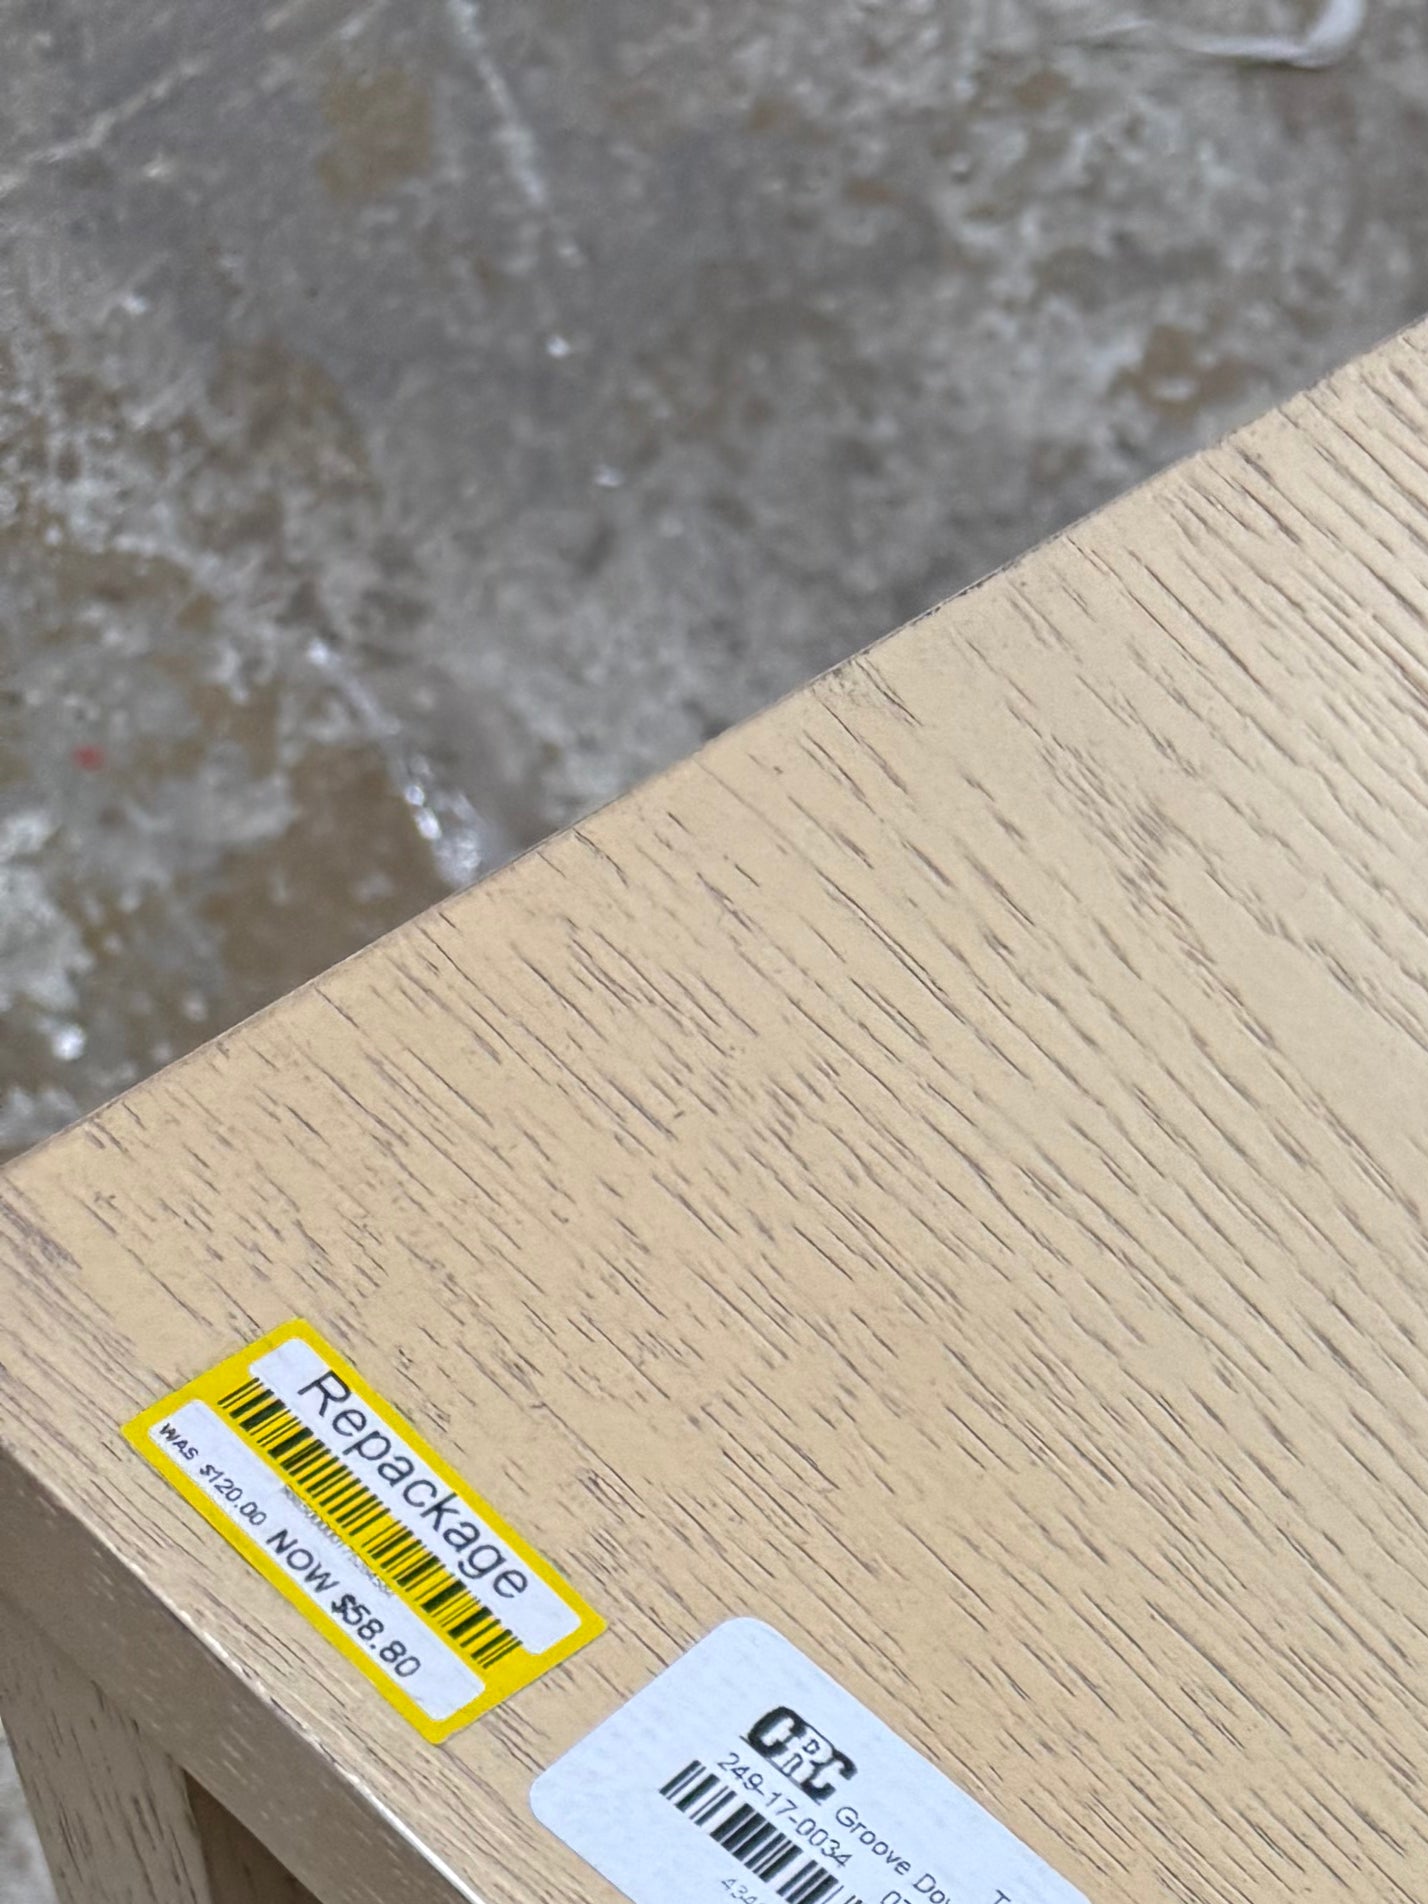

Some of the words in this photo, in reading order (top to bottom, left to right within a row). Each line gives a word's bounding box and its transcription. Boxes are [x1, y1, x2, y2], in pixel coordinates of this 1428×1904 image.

[159, 1423, 199, 1461] WAS
[200, 1463, 267, 1527] $120.00
[266, 1528, 339, 1594] NOW
[331, 1594, 421, 1678] $58.80
[298, 1369, 529, 1599] Repackage
[717, 1752, 852, 1869] 249-17-0034
[835, 1807, 912, 1876] Groove
